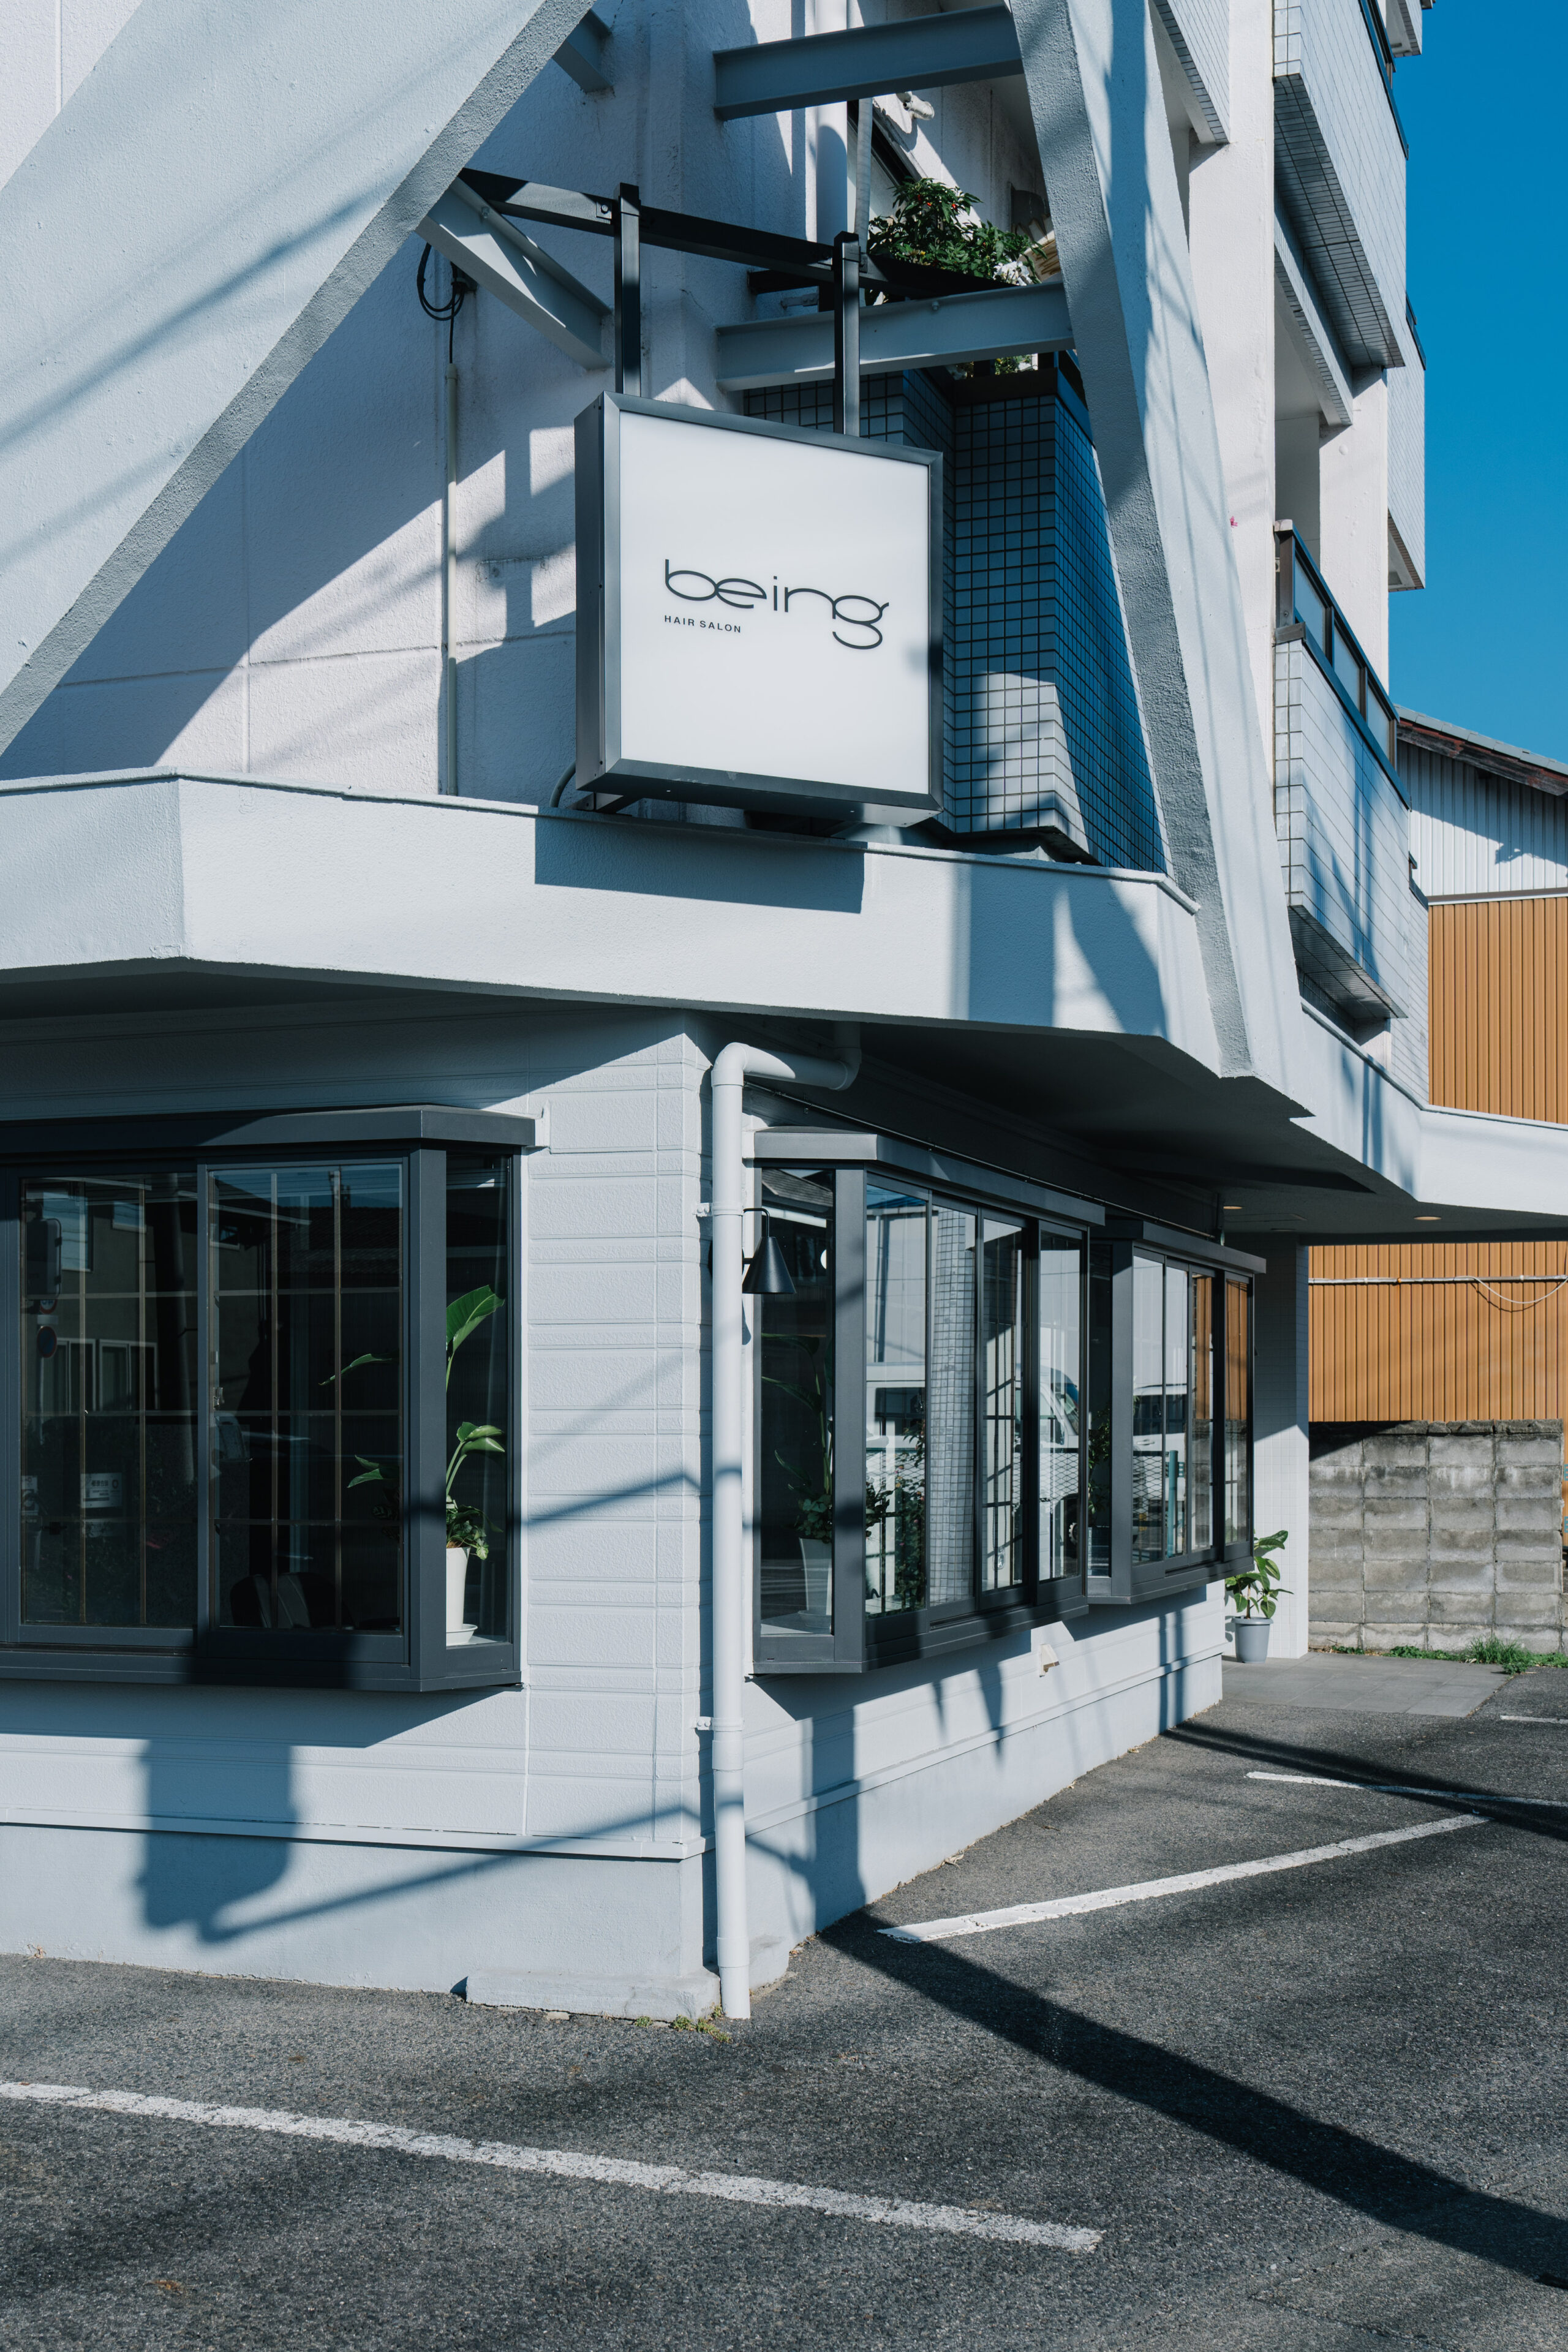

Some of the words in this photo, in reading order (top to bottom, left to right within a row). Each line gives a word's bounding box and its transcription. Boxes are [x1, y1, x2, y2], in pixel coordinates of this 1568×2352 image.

[664, 615, 695, 627] HAIR
[699, 620, 741, 633] SALON
[665, 559, 889, 650] being
